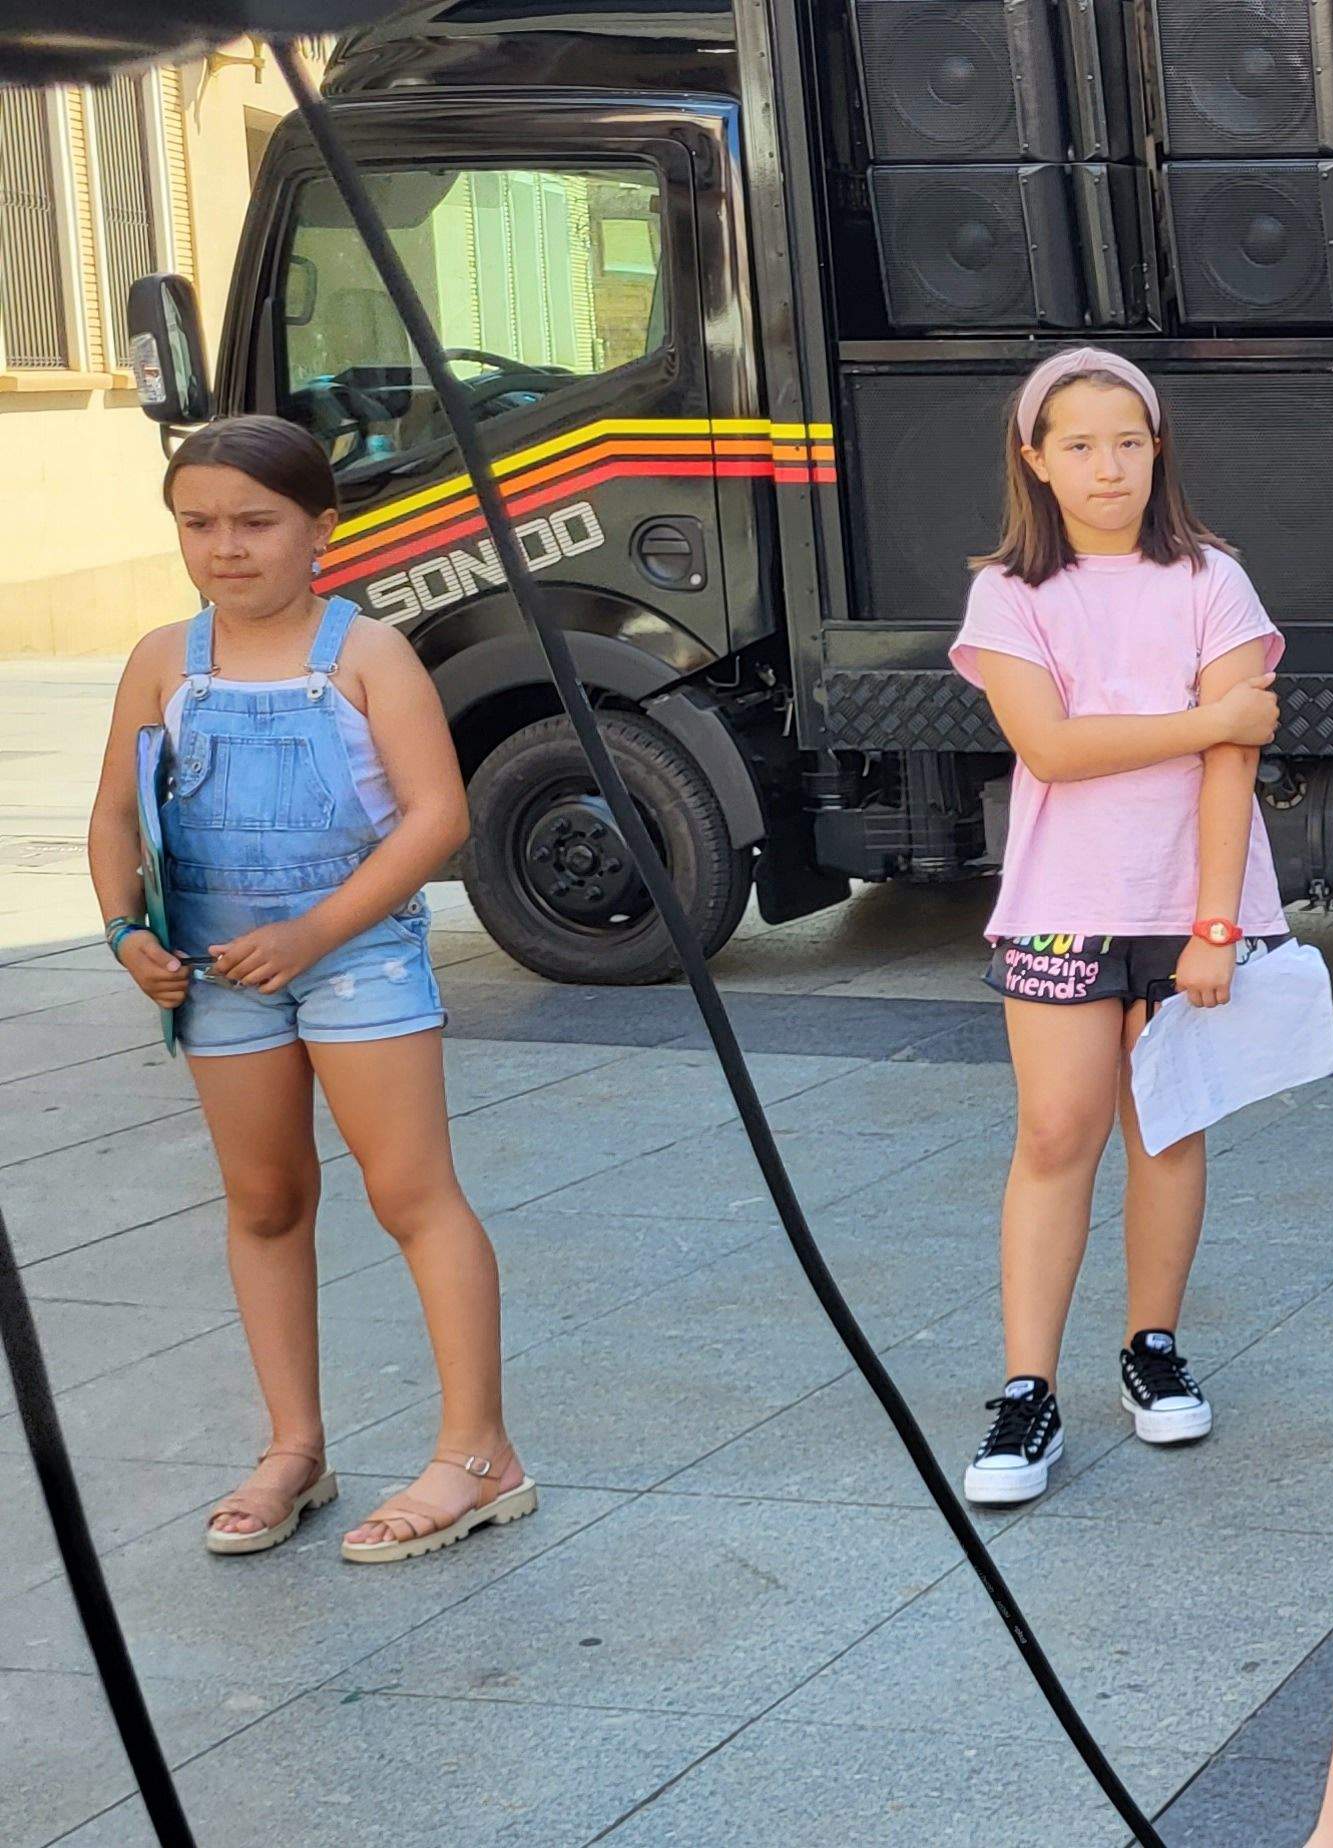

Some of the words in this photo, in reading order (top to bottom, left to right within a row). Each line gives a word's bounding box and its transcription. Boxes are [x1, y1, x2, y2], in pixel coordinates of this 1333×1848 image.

[365, 500, 605, 628] SONDO
[1005, 948, 1099, 985] amazing
[1005, 967, 1088, 999] friends
